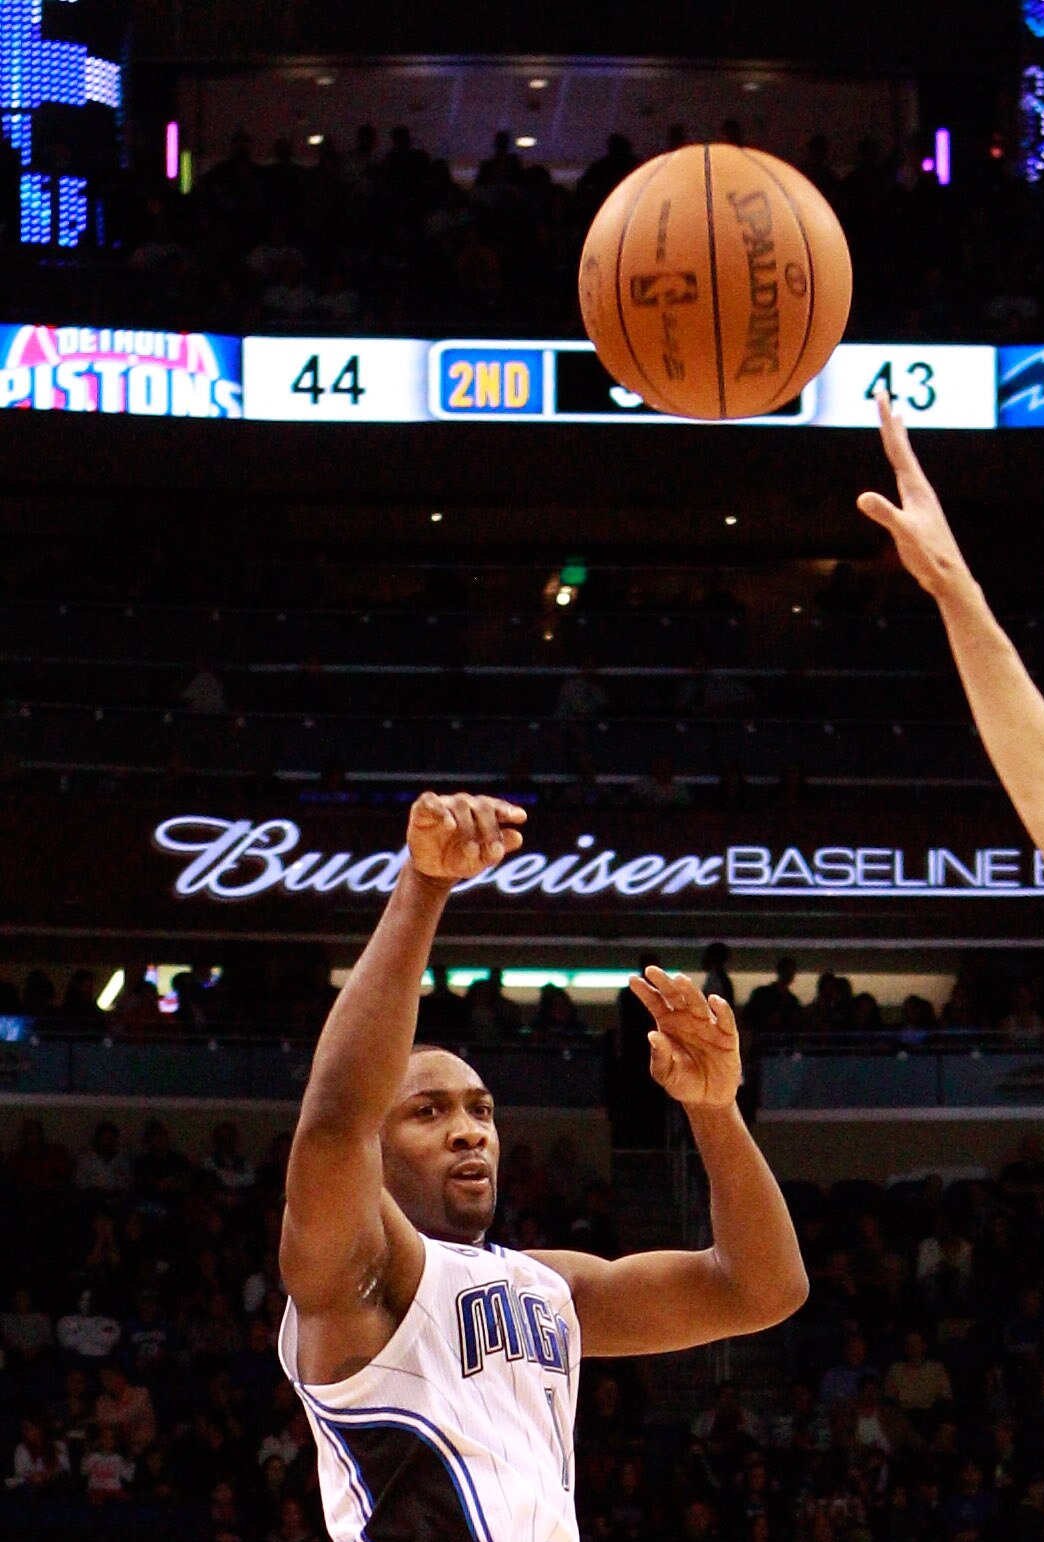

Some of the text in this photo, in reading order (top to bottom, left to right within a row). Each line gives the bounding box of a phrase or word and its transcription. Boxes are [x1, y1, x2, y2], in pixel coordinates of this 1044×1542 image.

[726, 189, 780, 382] SPALDING
[56, 326, 180, 361] DETROIT
[0, 360, 242, 419] PISTONS
[291, 353, 366, 405] 44
[447, 361, 530, 410] 2ND
[863, 361, 937, 411] 43
[154, 815, 718, 899] Budeiser
[727, 847, 1020, 888] BASELINE
